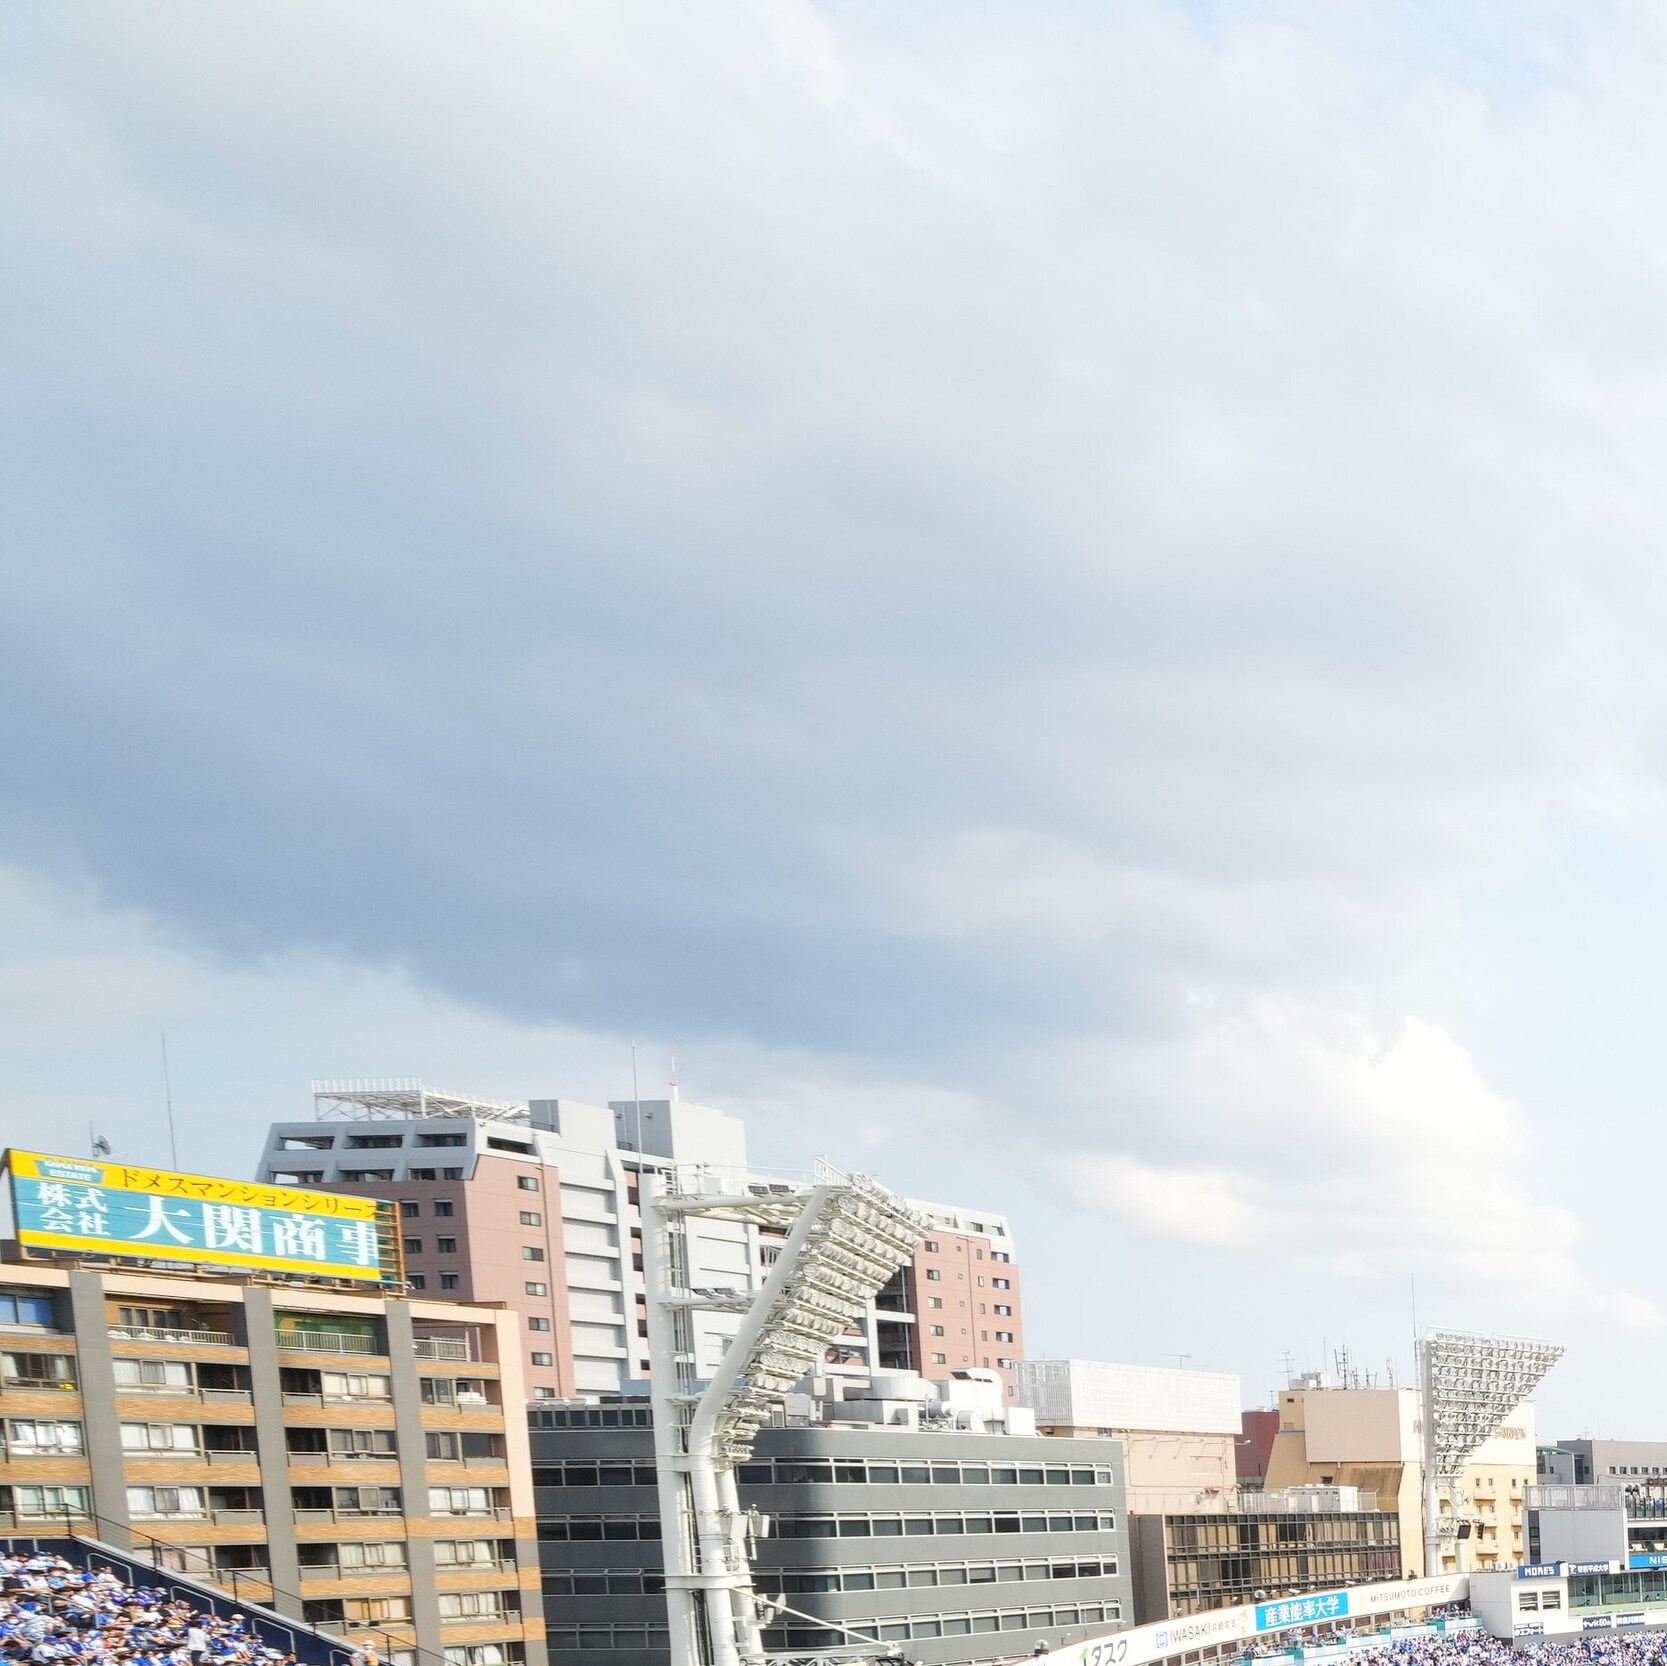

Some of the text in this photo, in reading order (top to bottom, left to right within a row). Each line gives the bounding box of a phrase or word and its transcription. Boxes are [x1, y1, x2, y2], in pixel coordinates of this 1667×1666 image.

[48, 1168, 92, 1183] ESTATE
[37, 1181, 109, 1213] 株式
[40, 1206, 111, 1238] 会社
[124, 1194, 380, 1266] 大関商事
[1370, 1584, 1451, 1603] MITSUMOTO COFFEE
[1264, 1596, 1340, 1628] 産業能率大学
[1170, 1624, 1211, 1644] IWASAKI
[1091, 1639, 1128, 1666] タスク
